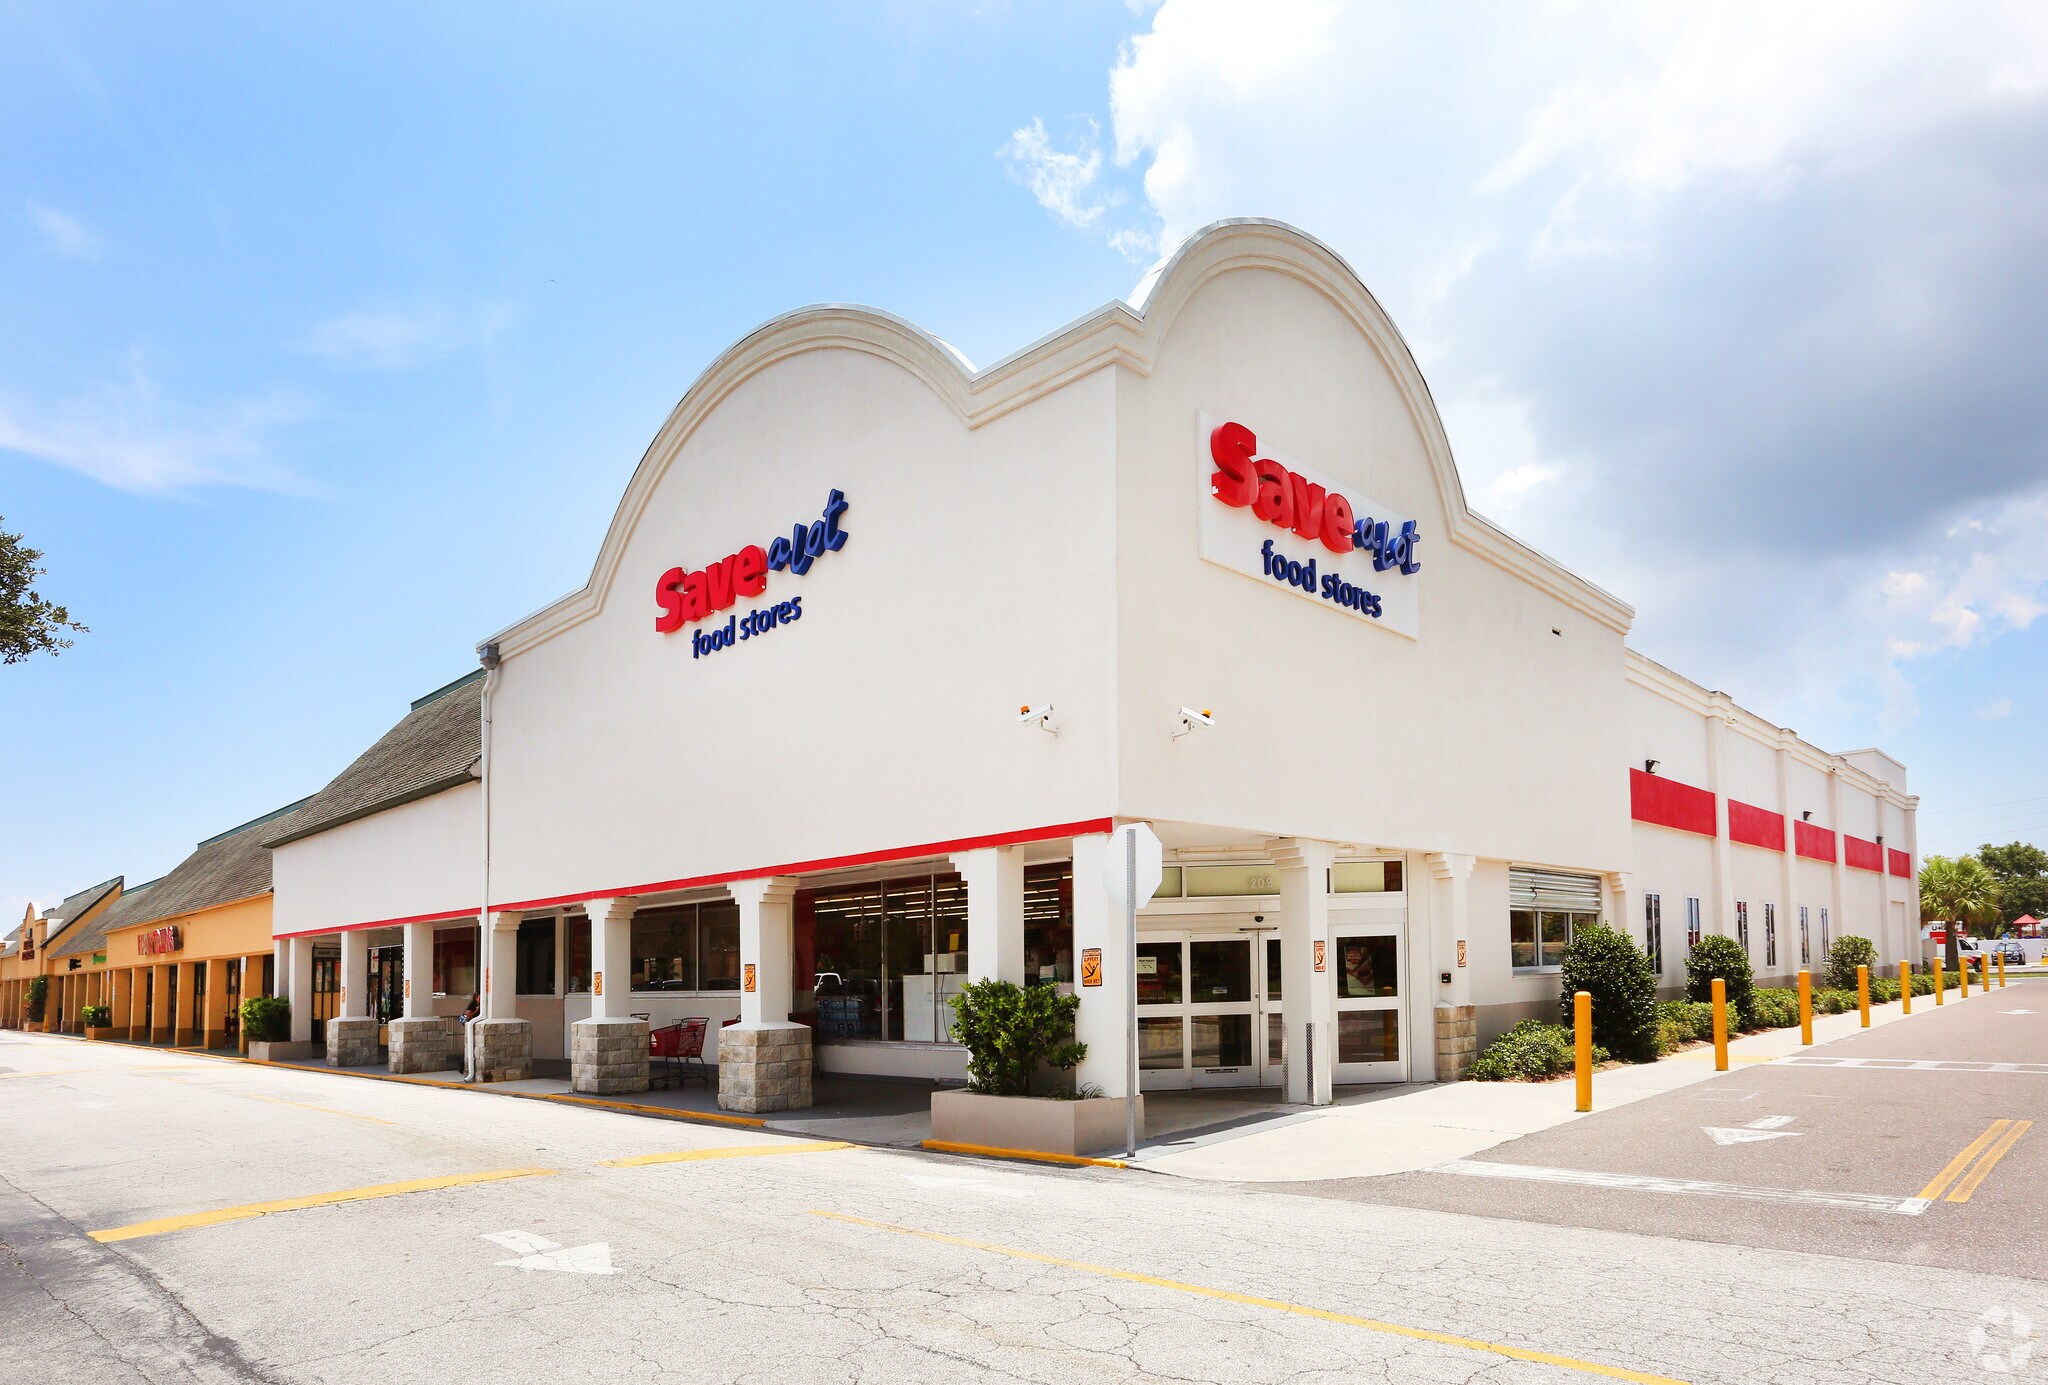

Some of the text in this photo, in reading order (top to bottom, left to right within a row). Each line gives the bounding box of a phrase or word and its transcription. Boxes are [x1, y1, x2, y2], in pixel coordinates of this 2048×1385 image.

[1210, 421, 1355, 554] Save
[656, 544, 768, 633] Save
[1261, 539, 1382, 618] food stores
[692, 596, 802, 659] food stores
[1250, 877, 1273, 889] 209
